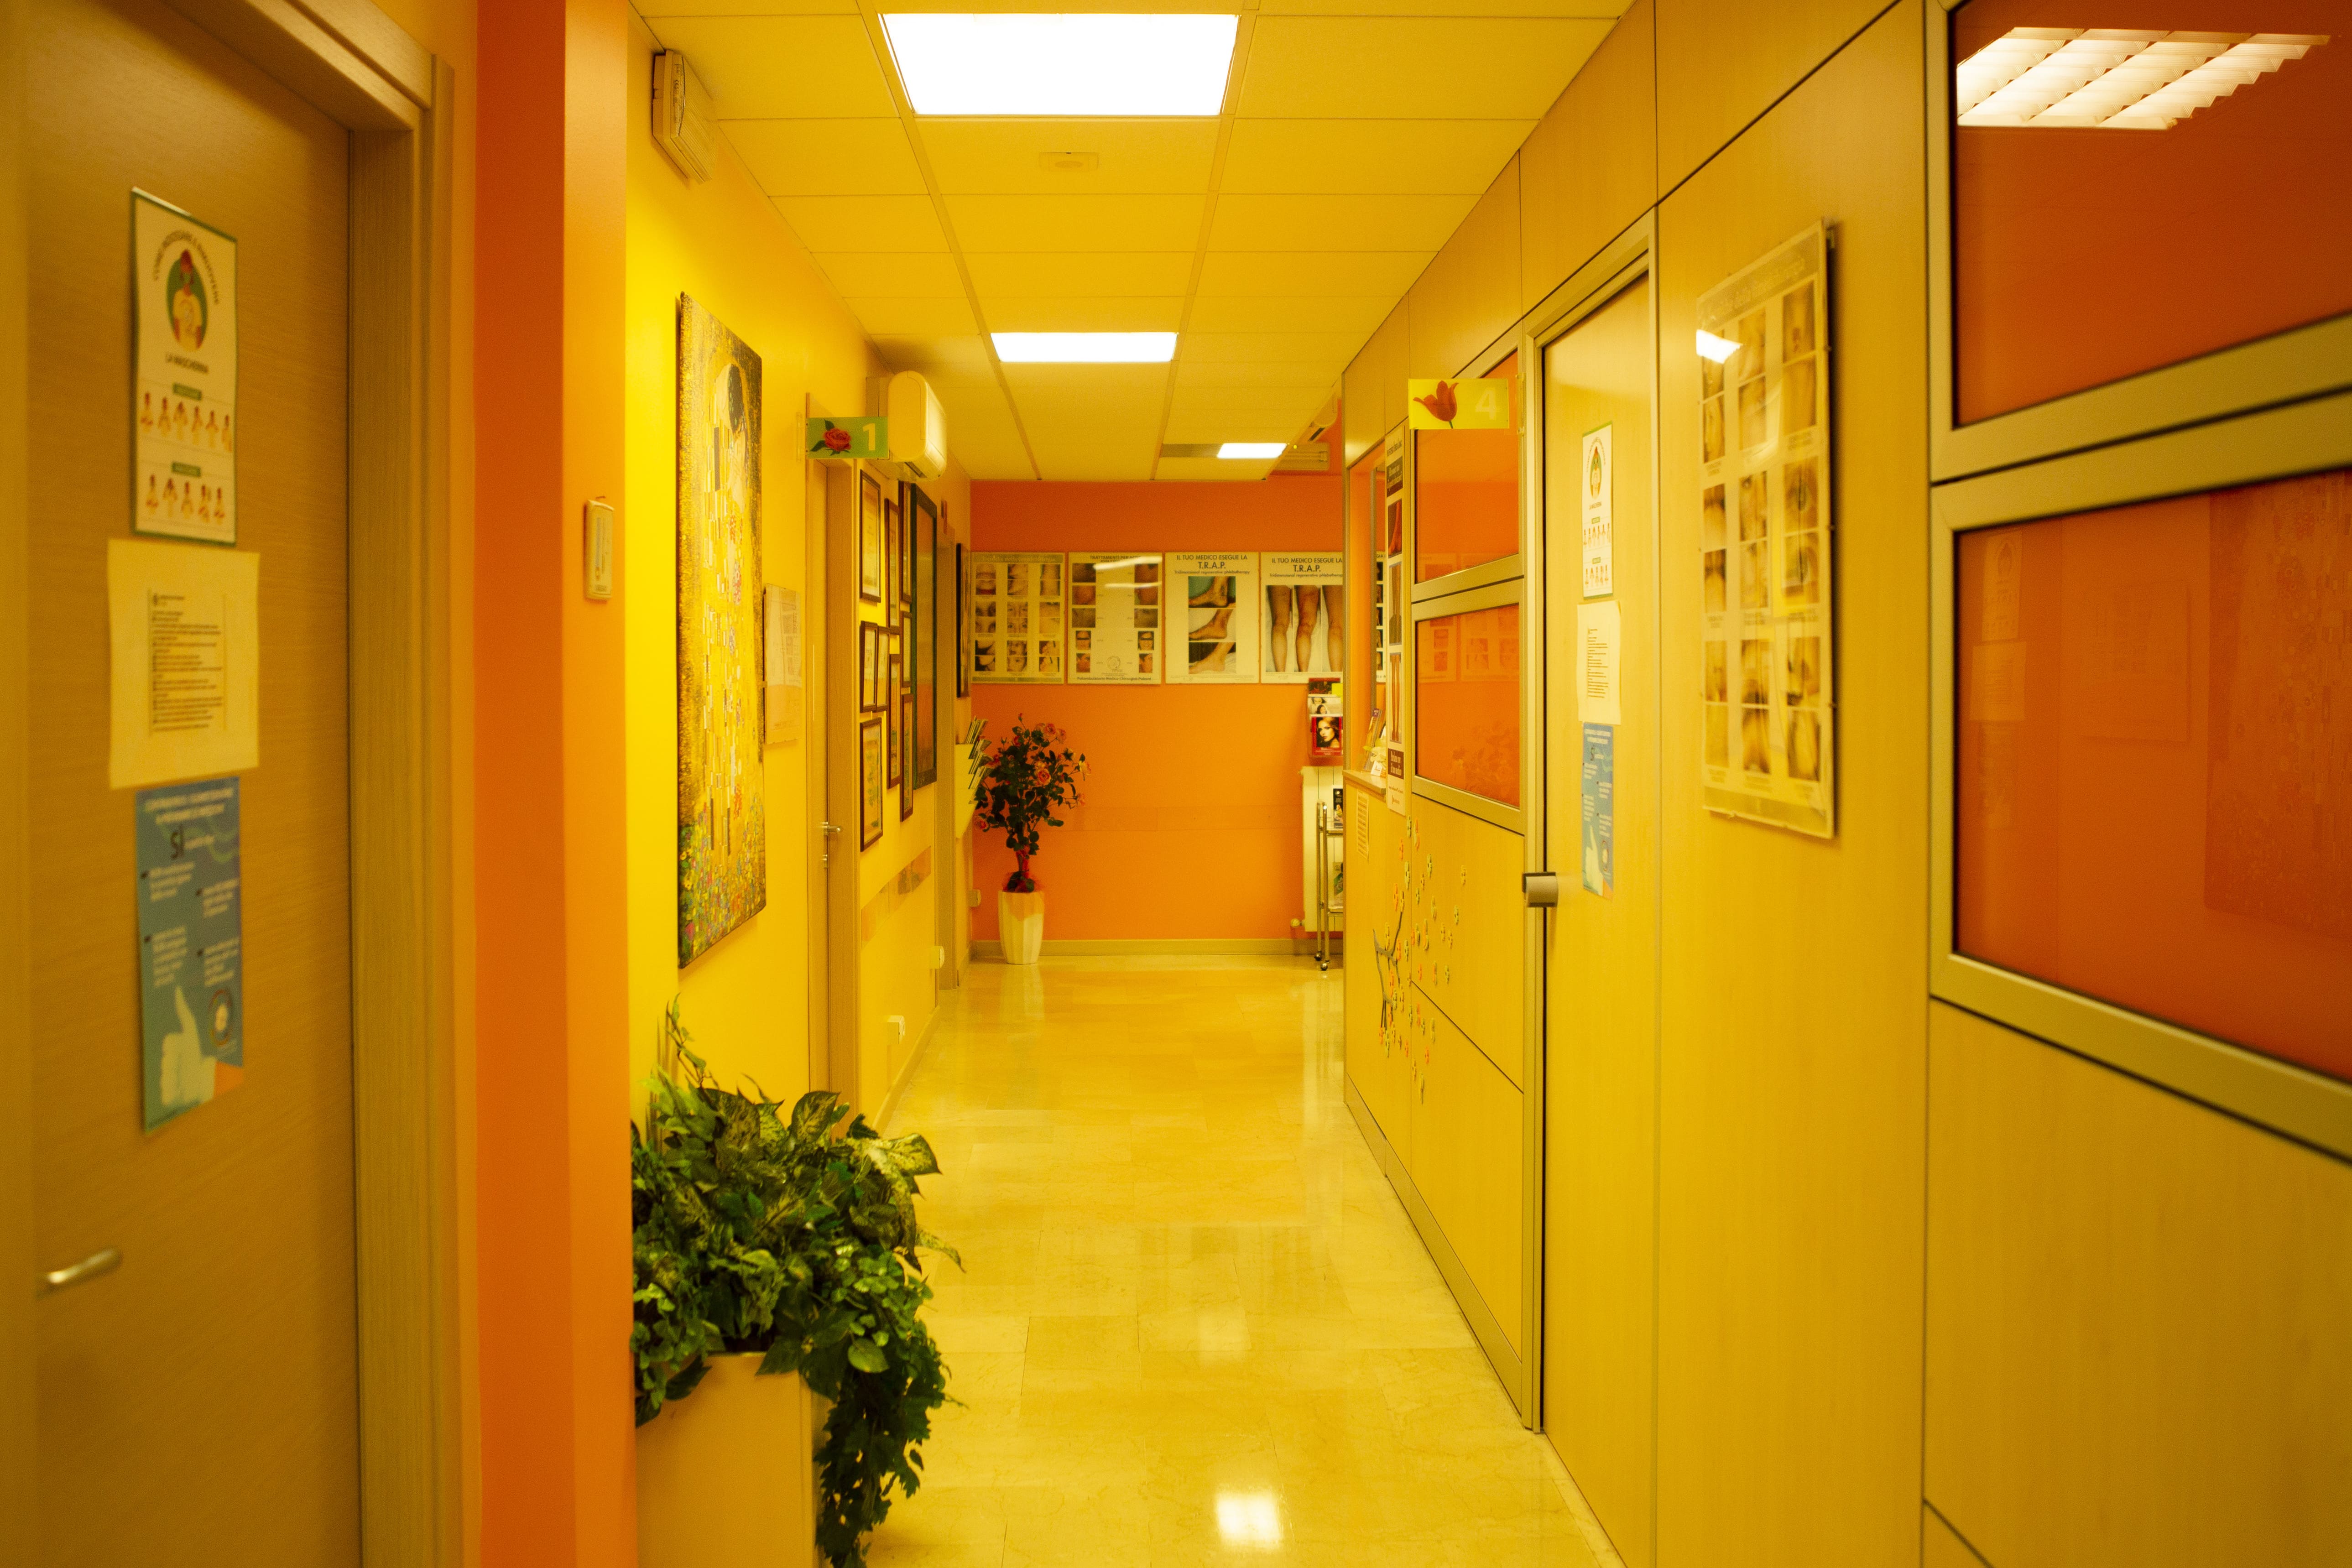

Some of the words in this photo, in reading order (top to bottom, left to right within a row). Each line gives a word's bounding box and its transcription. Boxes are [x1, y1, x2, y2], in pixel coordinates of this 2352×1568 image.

[1475, 387, 1497, 420] 4
[862, 423, 876, 452] 1
[1198, 561, 1226, 569] T.R.A.P.
[1293, 564, 1321, 573] T.R.A.P.
